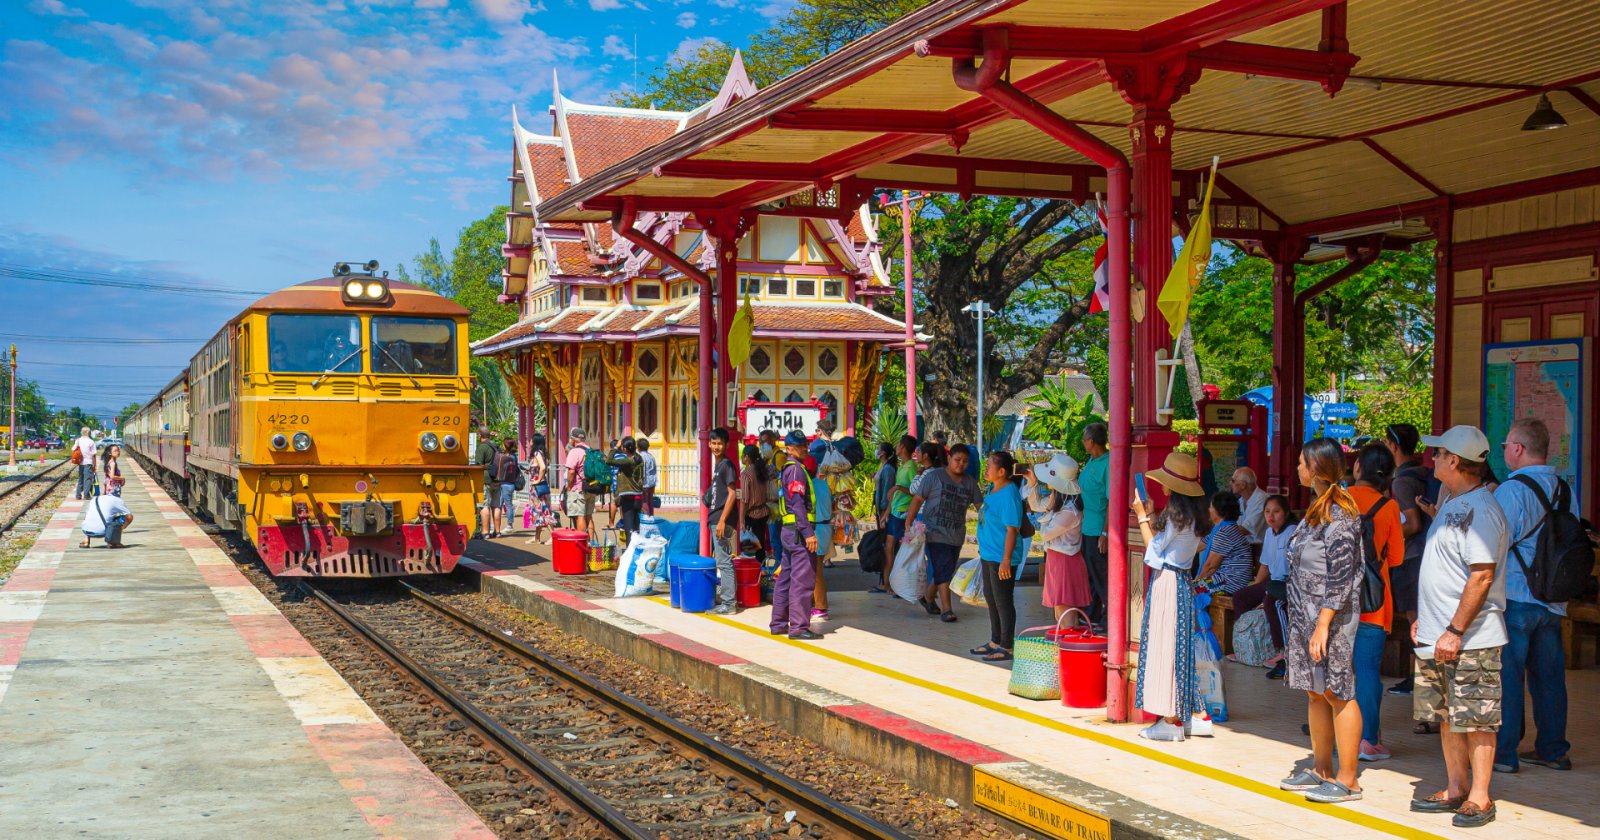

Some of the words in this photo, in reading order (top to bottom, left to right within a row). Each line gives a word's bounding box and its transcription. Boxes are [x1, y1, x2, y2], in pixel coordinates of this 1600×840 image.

[267, 414, 310, 425] 4220
[422, 415, 461, 426] 4220
[1028, 803, 1061, 829] BEWARE
[1063, 818, 1074, 833] OF
